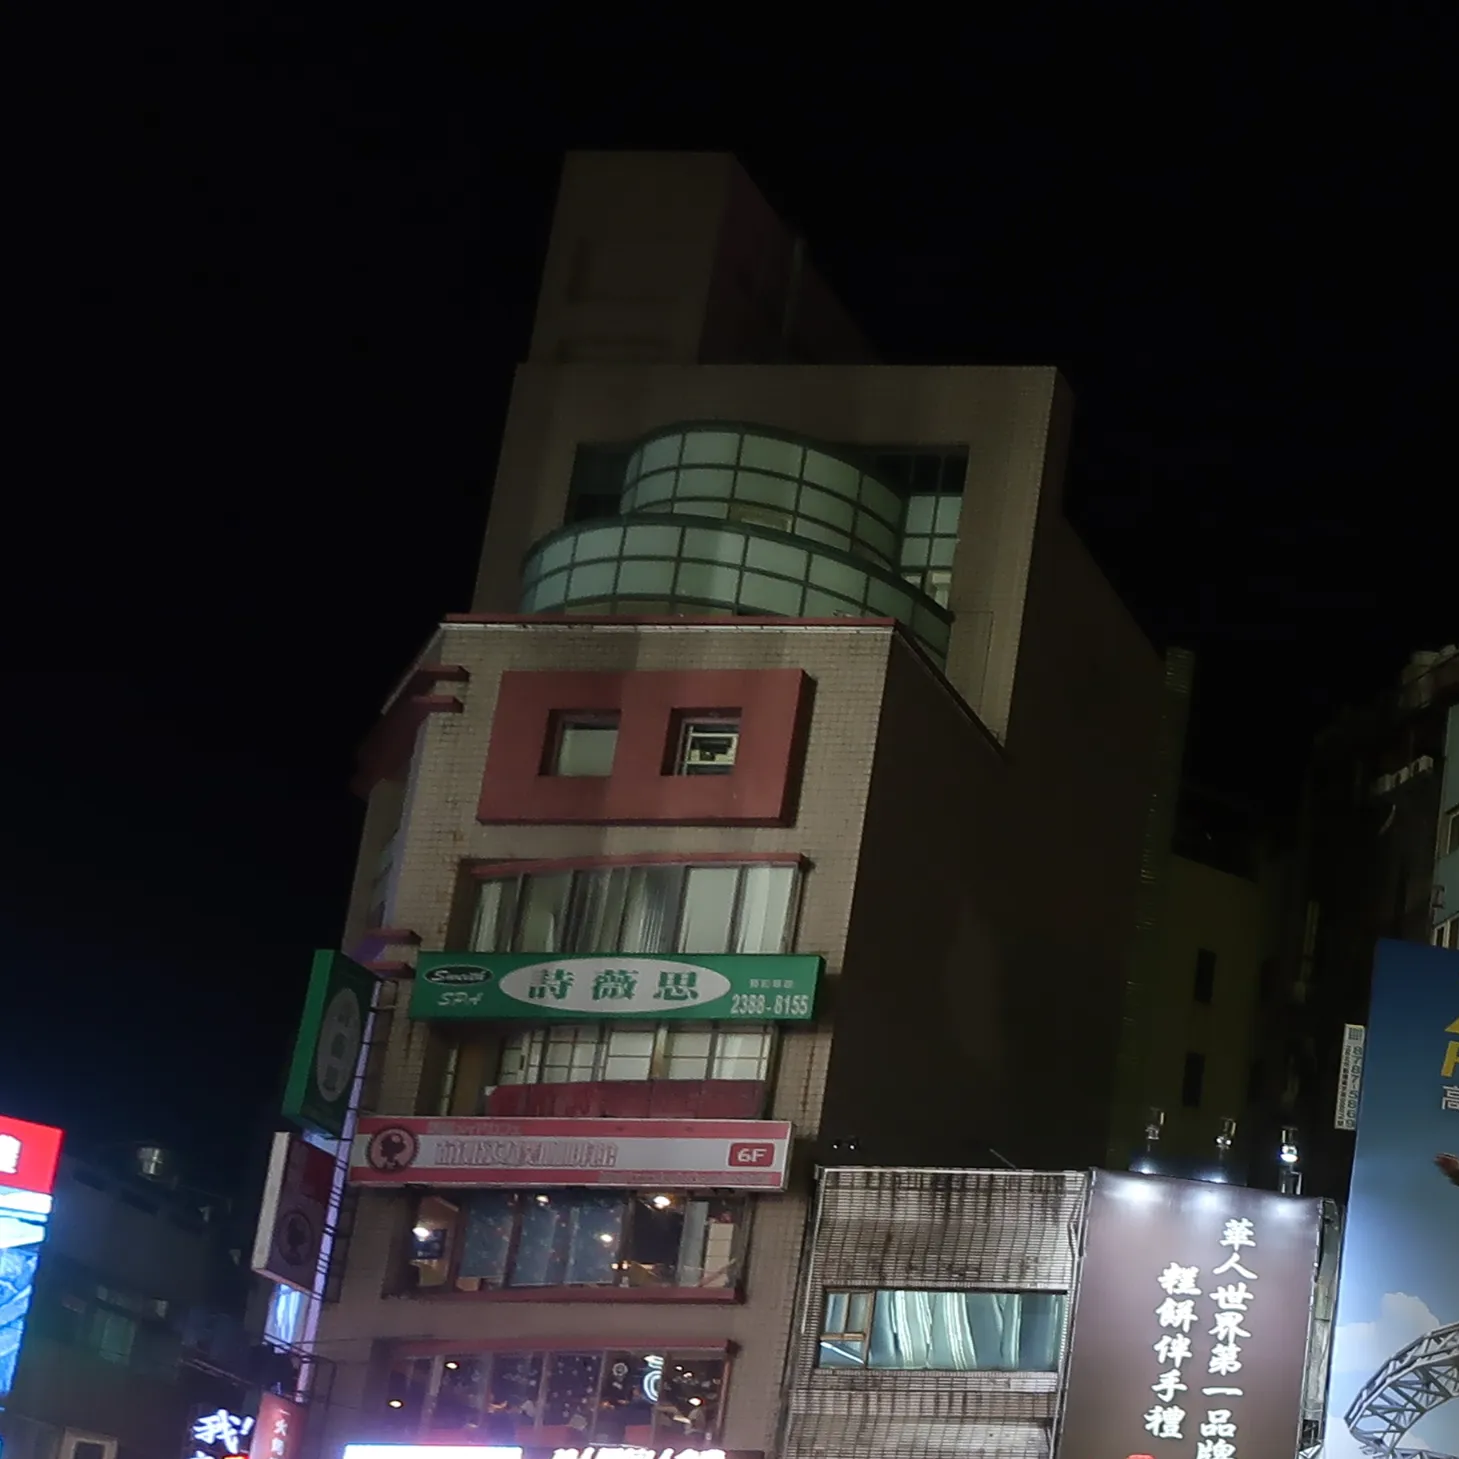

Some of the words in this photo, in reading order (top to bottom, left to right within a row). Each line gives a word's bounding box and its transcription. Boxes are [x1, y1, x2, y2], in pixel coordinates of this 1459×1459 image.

[528, 968, 699, 1002] 詩薇思
[736, 1147, 768, 1164] 6F
